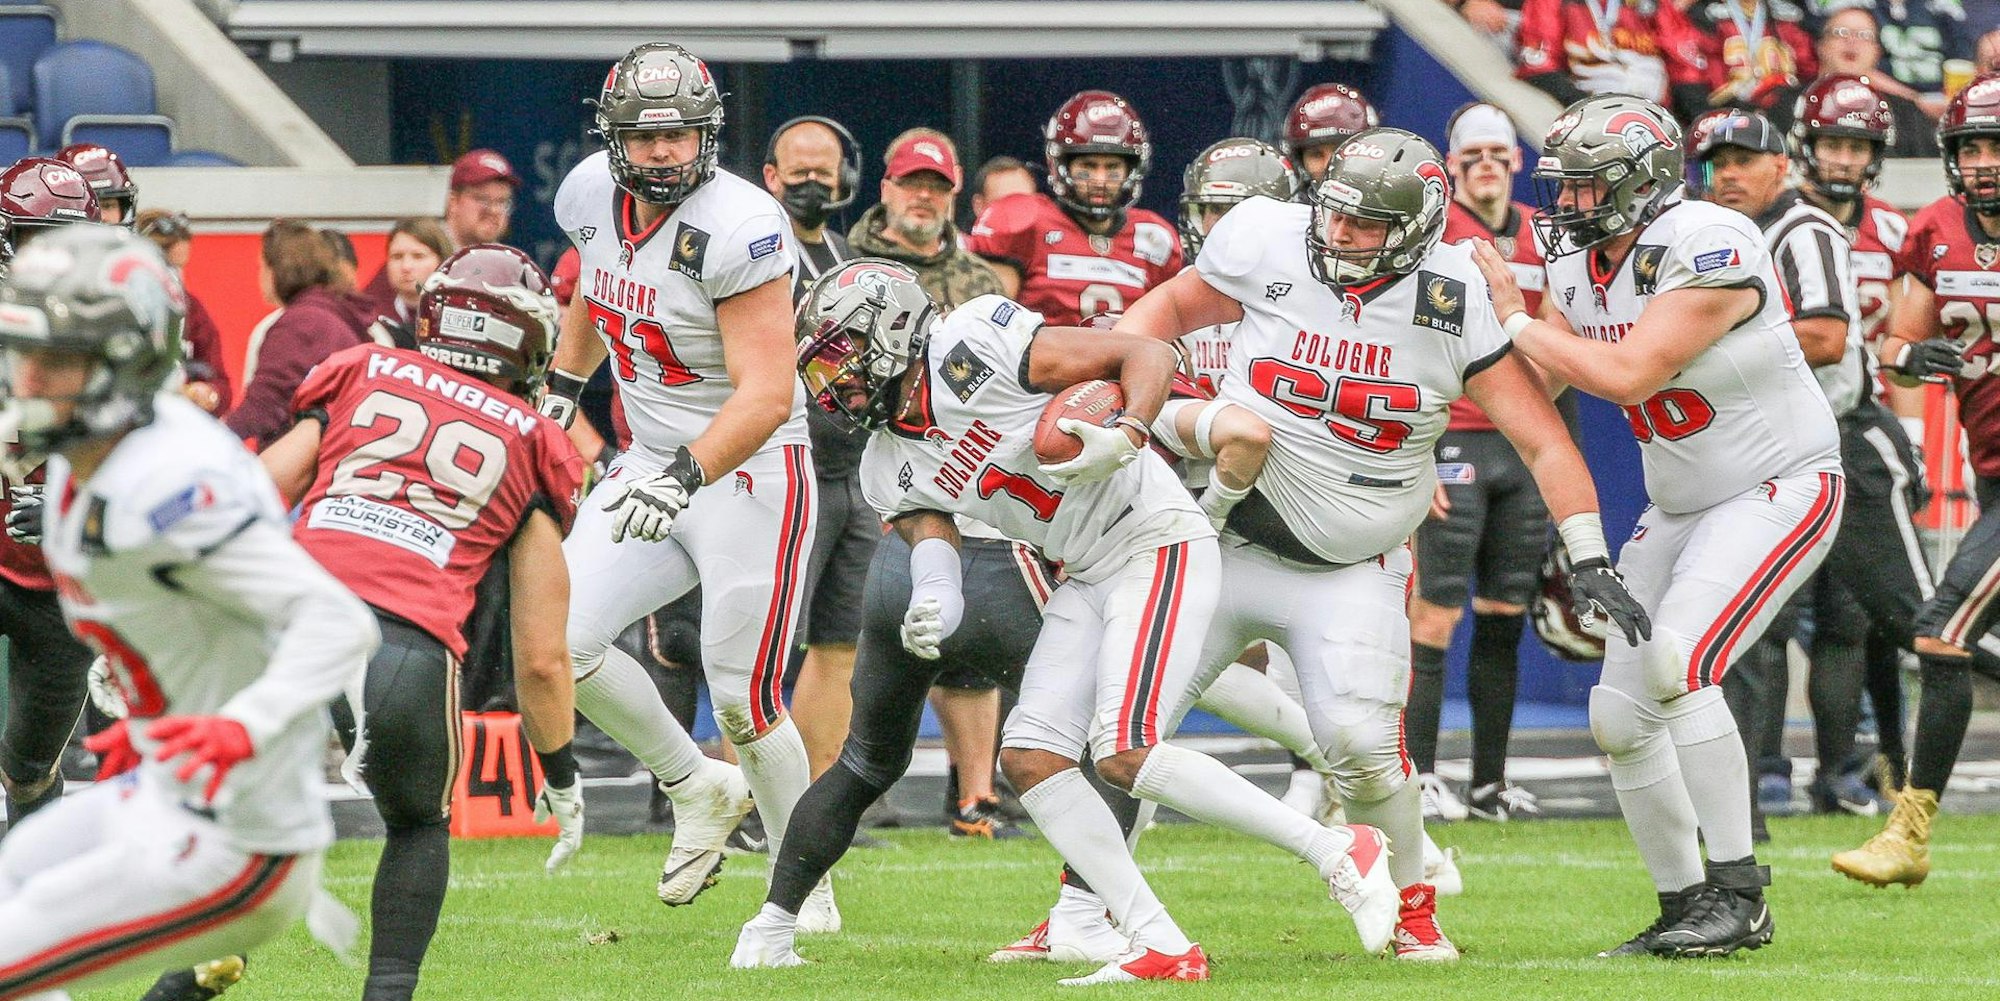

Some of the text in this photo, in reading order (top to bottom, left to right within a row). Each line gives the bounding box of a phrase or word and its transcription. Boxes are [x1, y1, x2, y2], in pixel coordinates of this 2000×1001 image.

[639, 66, 680, 82] Chio
[593, 268, 657, 317] COLOGNE
[584, 295, 704, 387] 71
[1414, 314, 1462, 335] 28 BLACK
[1291, 330, 1392, 377] COLOGNE
[967, 366, 994, 393] BLACK
[1084, 393, 1119, 416] Wilson
[1249, 357, 1421, 454] 65
[326, 389, 508, 530] 29
[933, 419, 1003, 500] COLOGNE
[977, 462, 1065, 523] 1
[326, 505, 436, 547] TOURISTER
[334, 497, 443, 539] AMERICAN
